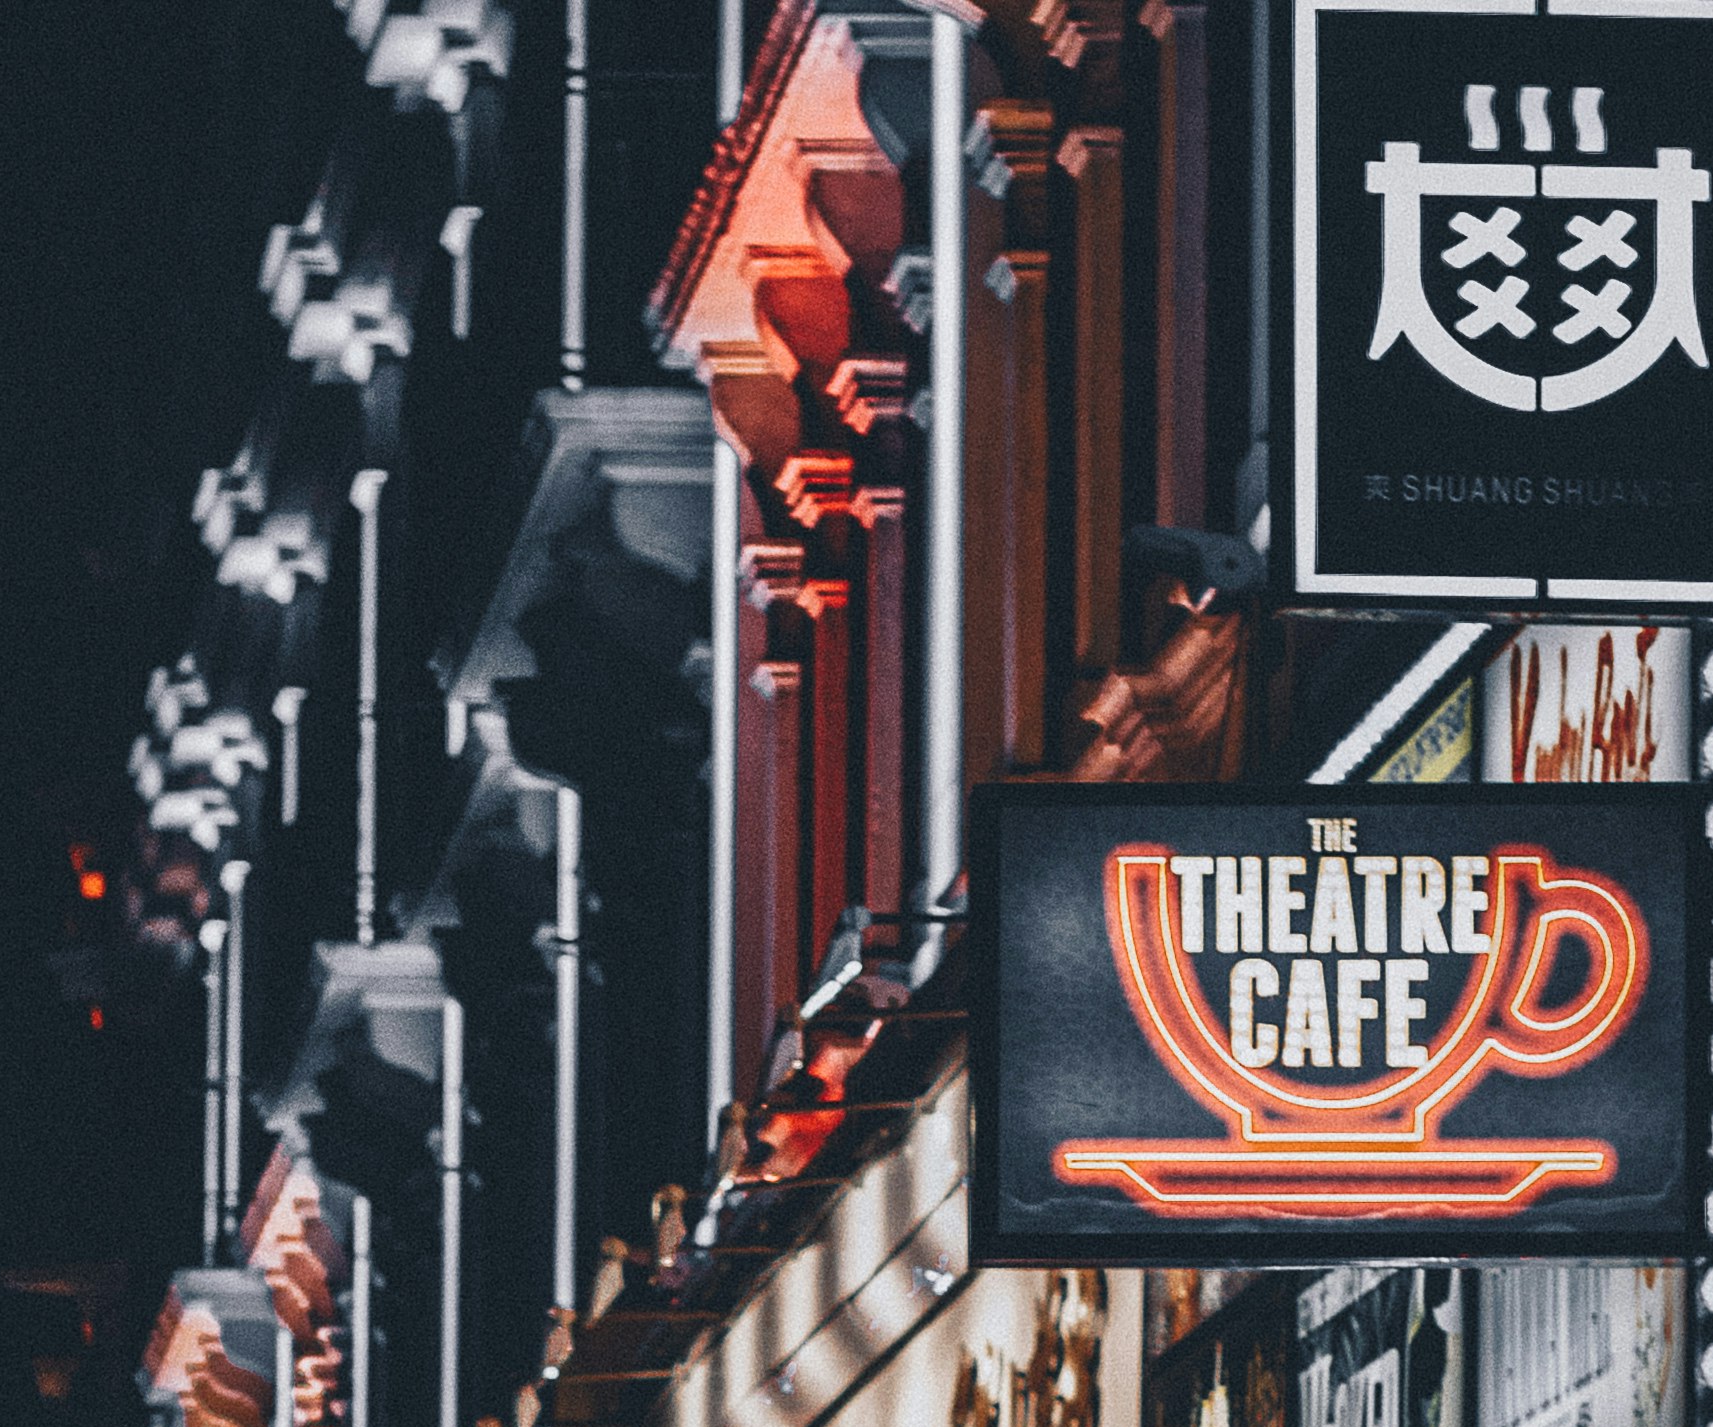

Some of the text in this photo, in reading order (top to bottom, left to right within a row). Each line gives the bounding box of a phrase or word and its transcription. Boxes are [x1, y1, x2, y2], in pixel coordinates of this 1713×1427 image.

[1402, 474, 1534, 504] SHUANG
[1306, 817, 1357, 852] THE
[1170, 856, 1492, 953] THEATRE
[1230, 958, 1429, 1068] CAFE
